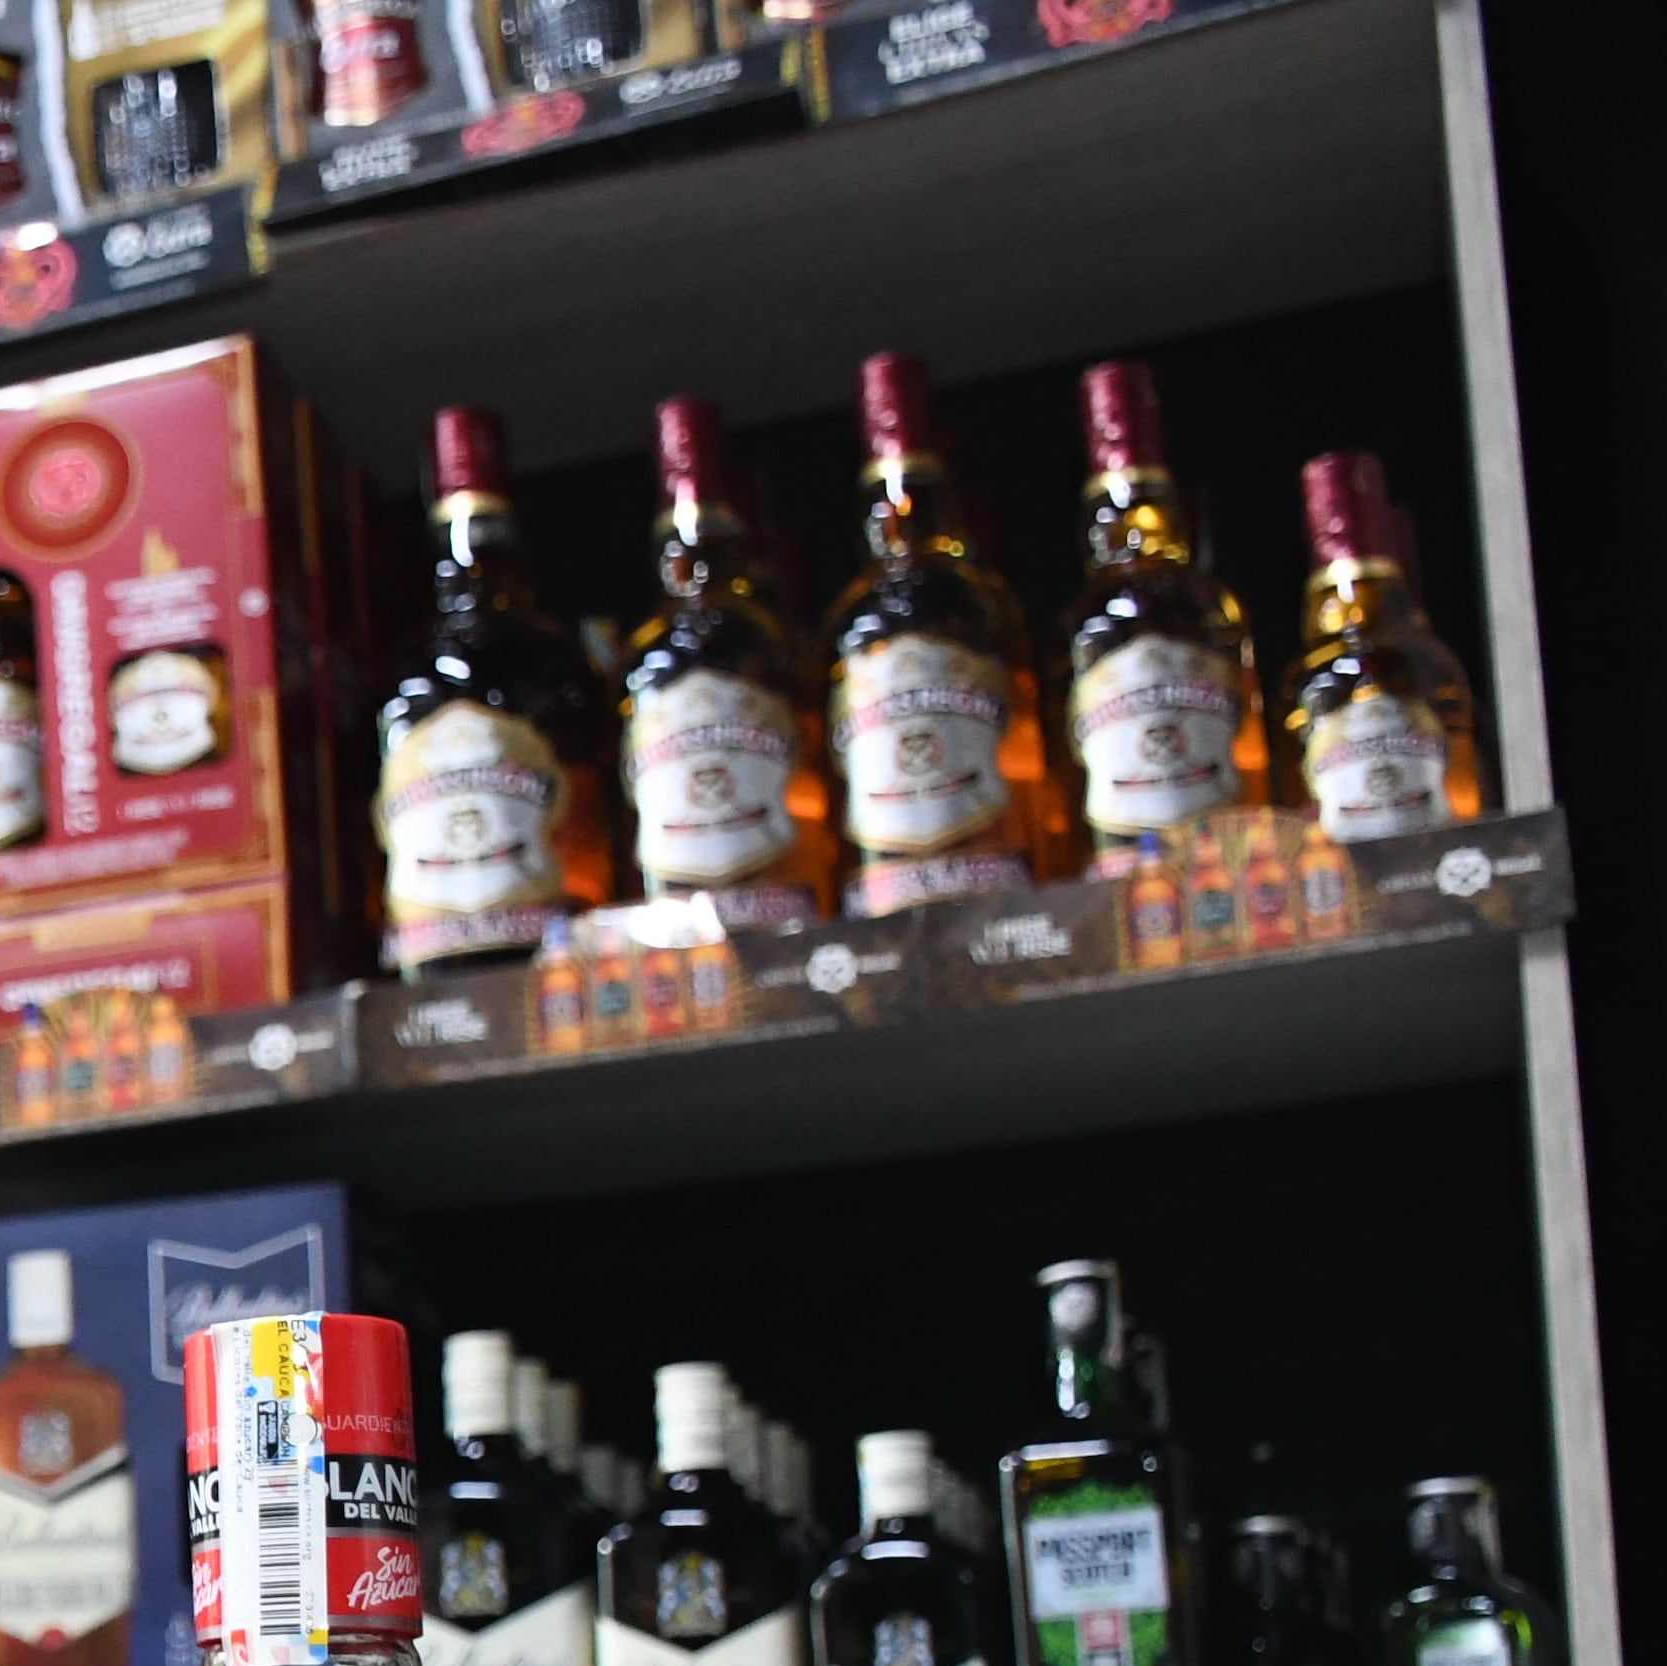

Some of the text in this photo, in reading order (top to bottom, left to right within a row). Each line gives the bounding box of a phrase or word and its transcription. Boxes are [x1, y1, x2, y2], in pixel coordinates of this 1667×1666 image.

[276, 1320, 289, 1399] EL CAUCA
[344, 1503, 379, 1519] DEL
[376, 1546, 413, 1581] Sin
